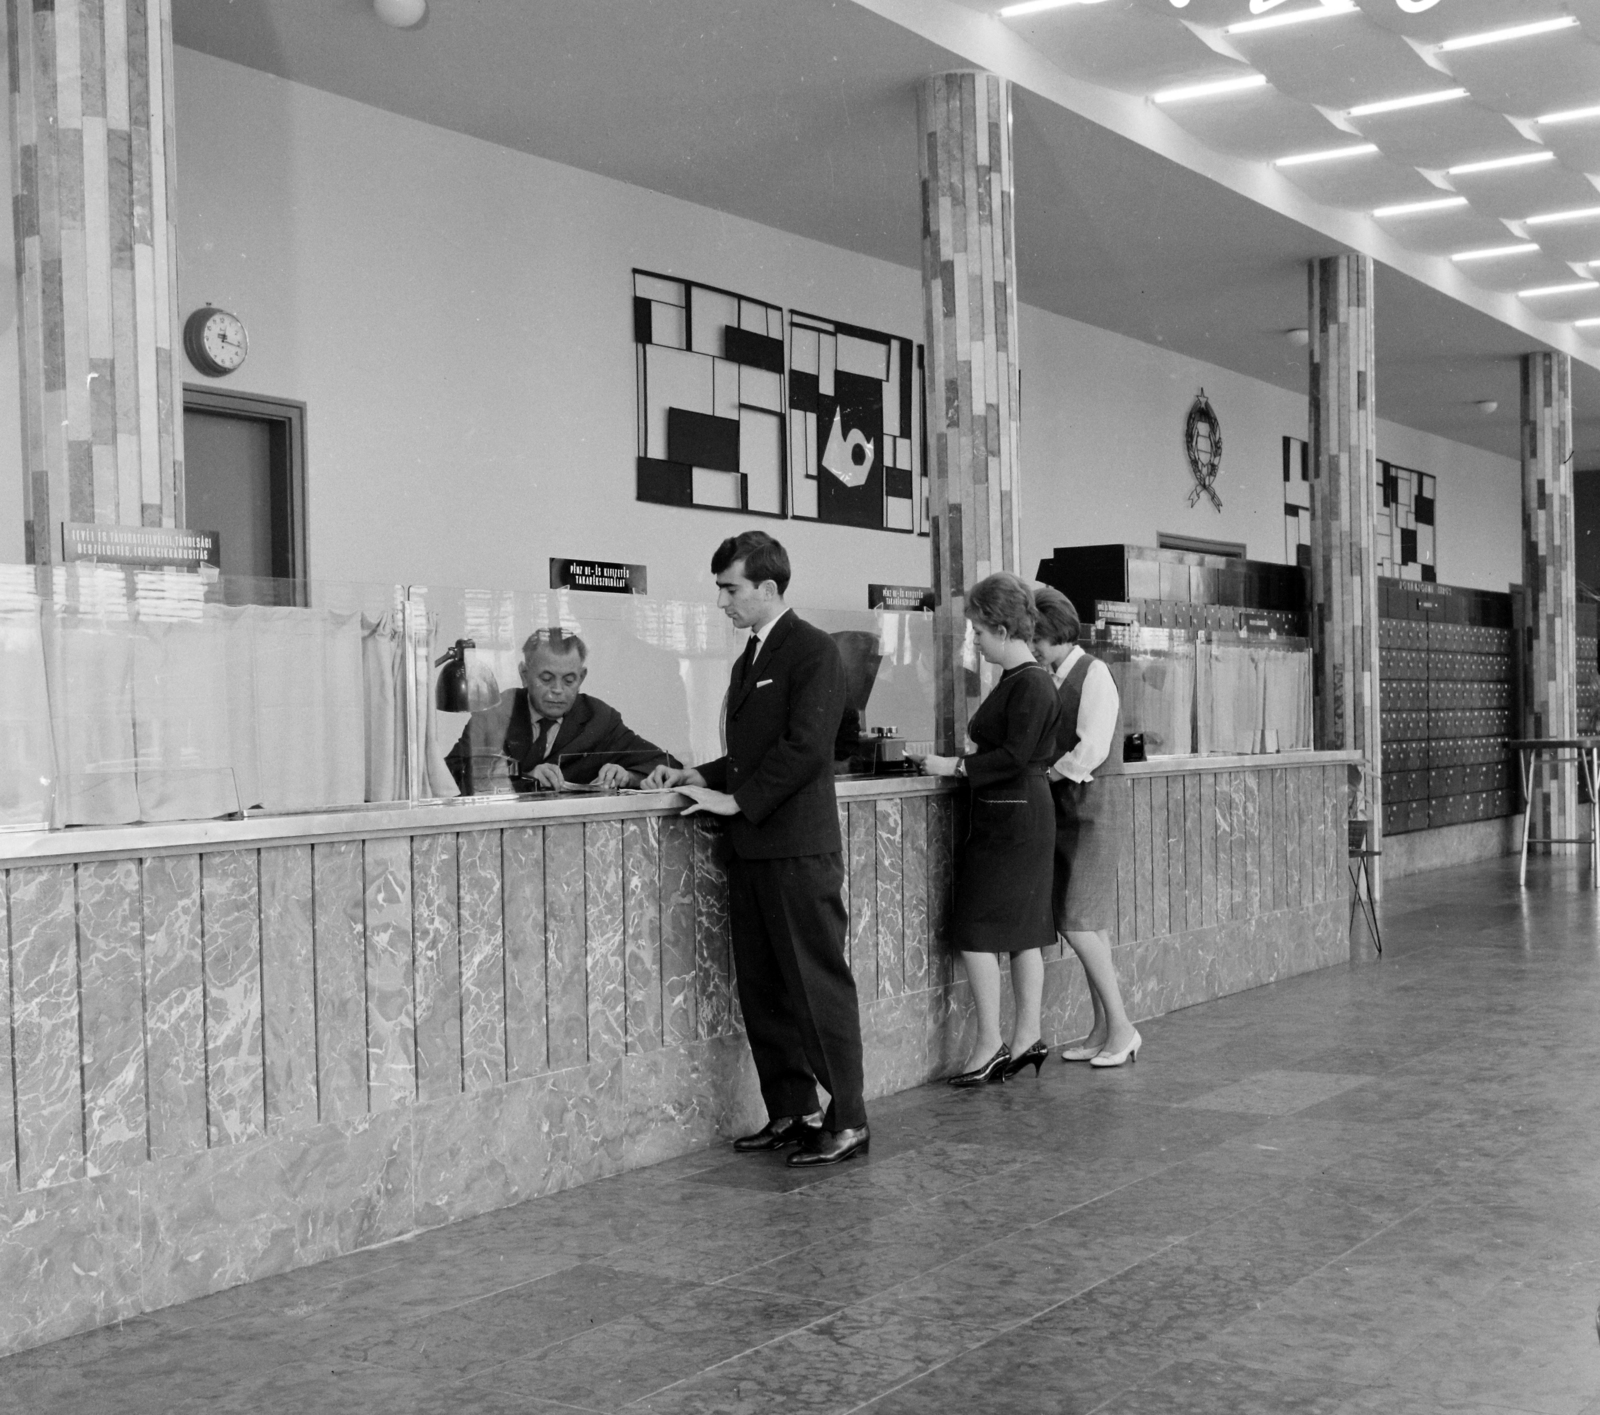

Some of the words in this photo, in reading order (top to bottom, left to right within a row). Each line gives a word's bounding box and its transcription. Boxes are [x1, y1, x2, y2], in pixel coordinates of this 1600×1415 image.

[72, 528, 94, 541] LEVÉL
[98, 529, 107, 542] ÉS
[570, 562, 583, 574] PÉNZ
[604, 566, 629, 578] KIFIZETÉS
